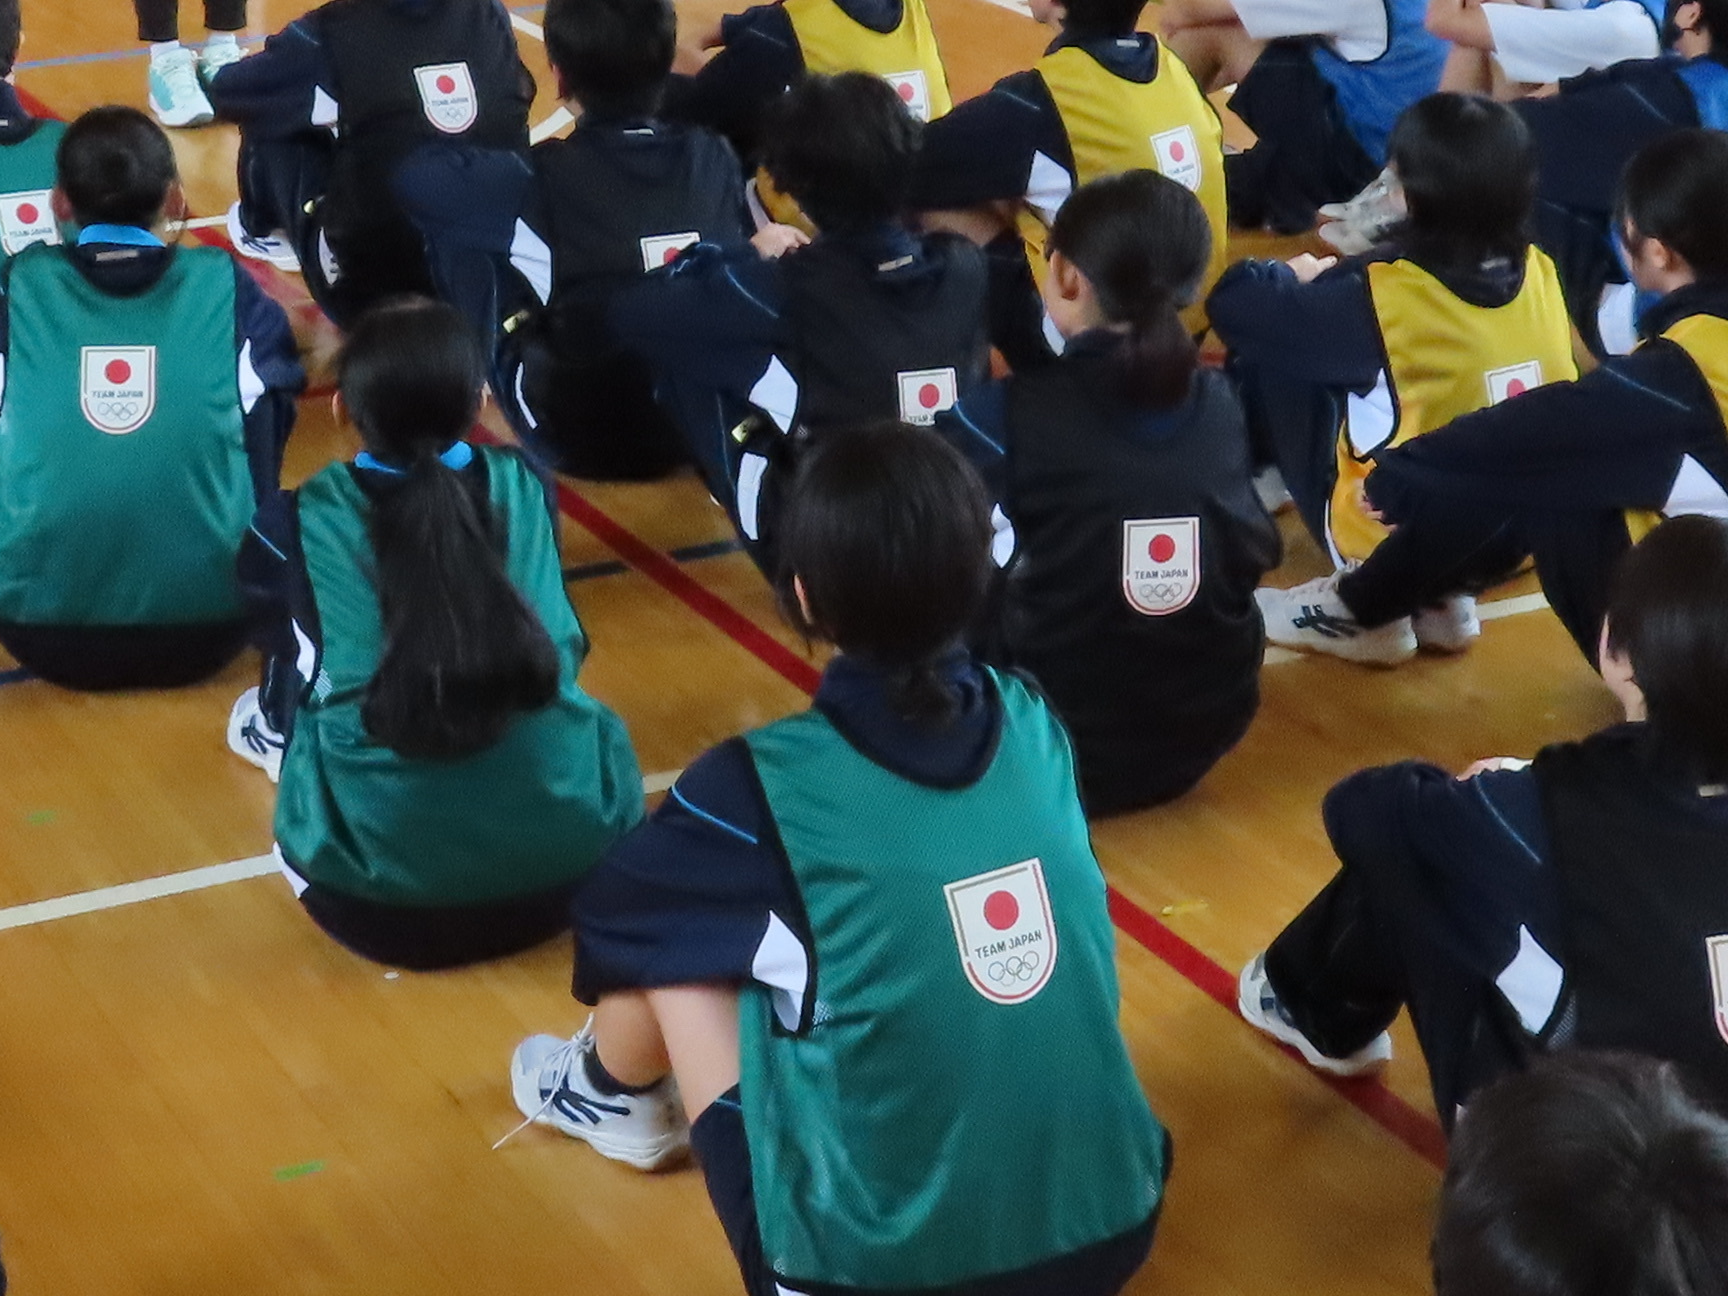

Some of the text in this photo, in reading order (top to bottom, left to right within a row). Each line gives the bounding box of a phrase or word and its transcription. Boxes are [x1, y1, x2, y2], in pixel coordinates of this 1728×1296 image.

[92, 390, 143, 399] TEAM JAPAN
[1135, 570, 1188, 580] TEAM JAPAN
[975, 930, 1042, 959] TEAM JAPAN
